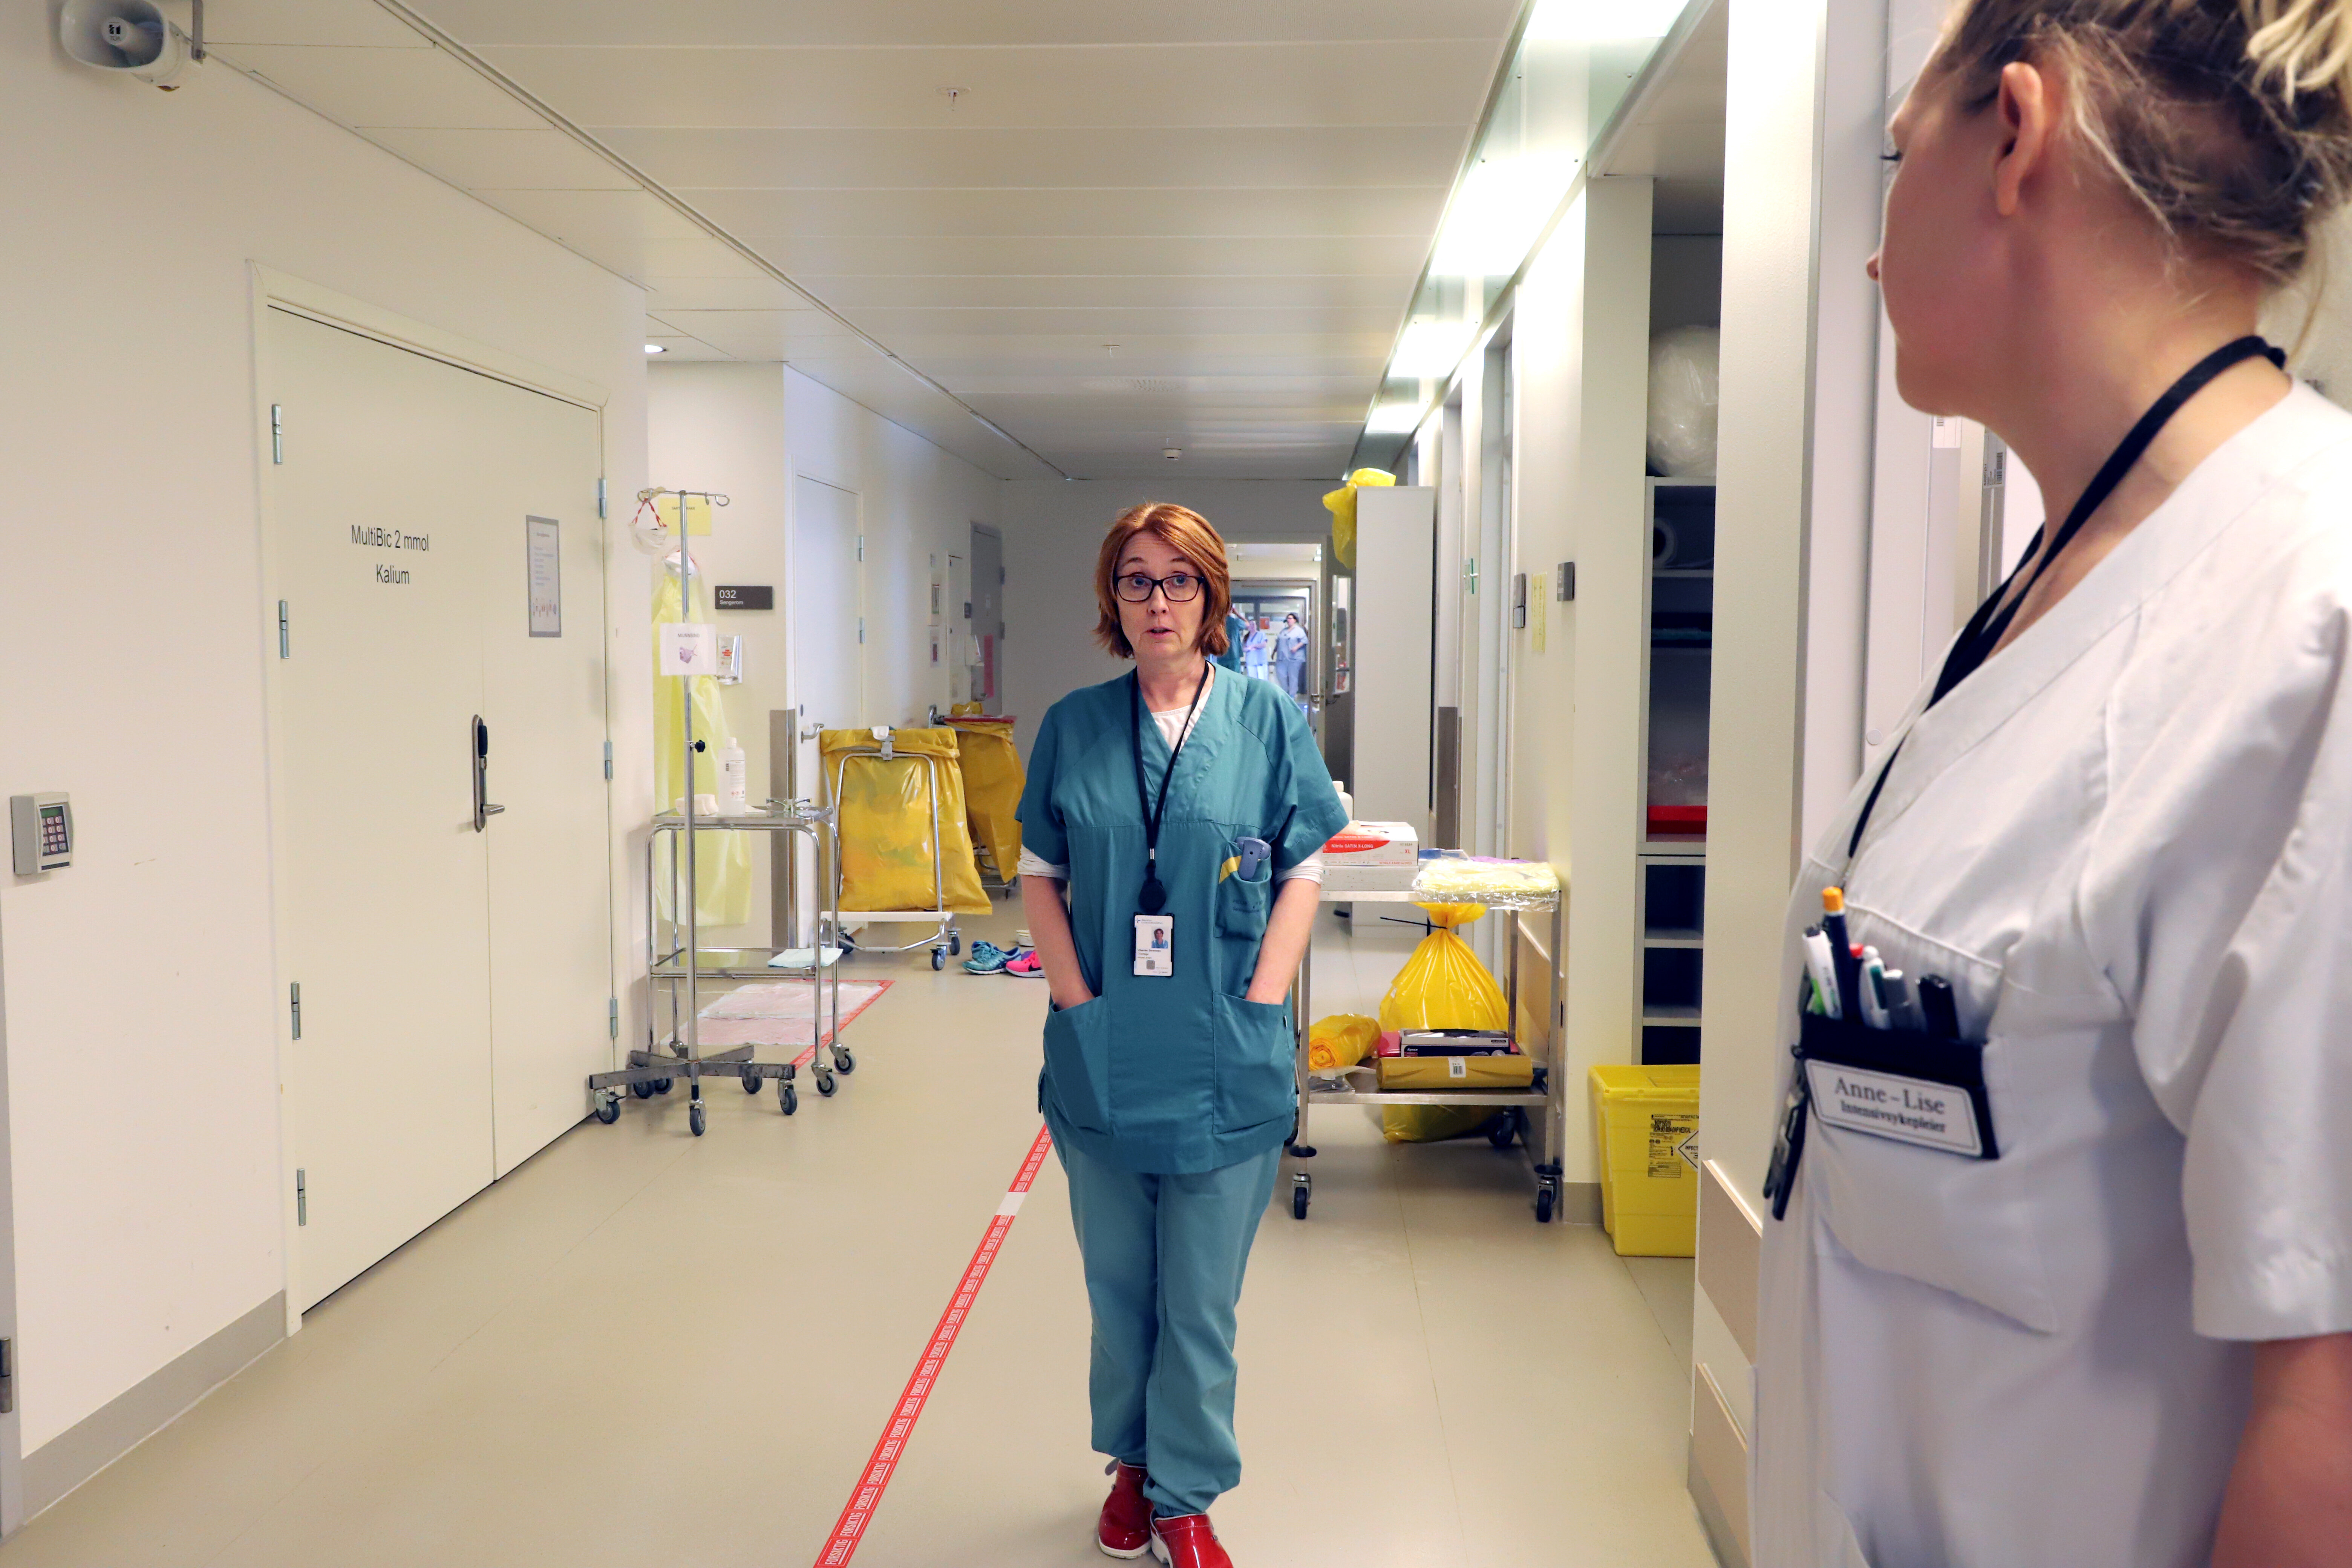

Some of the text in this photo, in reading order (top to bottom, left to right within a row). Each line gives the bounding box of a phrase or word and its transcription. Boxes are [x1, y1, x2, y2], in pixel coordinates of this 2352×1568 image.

[351, 524, 429, 551] MultiBic 2 mmol
[376, 564, 410, 584] Kalium
[720, 590, 736, 599] 032
[938, 1325, 954, 1340] FORSIKTIG
[929, 1342, 945, 1357] FORSIKTIG
[920, 1360, 936, 1375] FORSIKTIG
[910, 1378, 927, 1395] FORSIKTIG
[900, 1398, 917, 1416] FORSIKTIG
[890, 1418, 908, 1437] FORSIKTIG
[879, 1440, 898, 1459] FORSIKTIG
[867, 1463, 887, 1484] FORSIKTIG
[854, 1487, 875, 1509] FORSIKTIG
[840, 1513, 862, 1536] FORSIKTIG
[825, 1539, 848, 1565] FORSIKTIG
